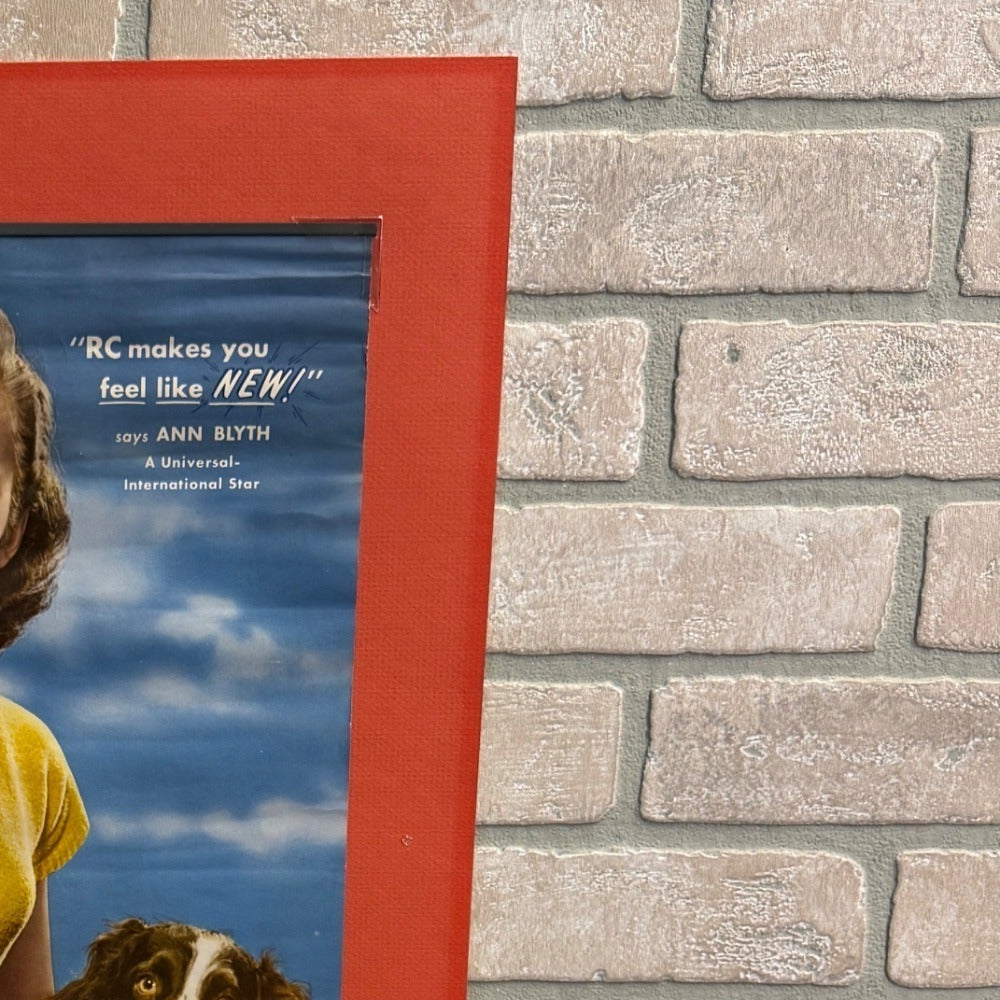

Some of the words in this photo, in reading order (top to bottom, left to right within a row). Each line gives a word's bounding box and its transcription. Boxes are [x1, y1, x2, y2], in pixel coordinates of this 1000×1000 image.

[128, 336, 212, 359] makes
[221, 342, 269, 363] you
[100, 376, 146, 399] feel
[156, 376, 203, 399] like
[115, 431, 149, 445] says
[156, 426, 203, 442] ANN
[214, 425, 270, 442] BLYTH
[145, 456, 155, 469] A
[161, 455, 241, 469] Universal-
[124, 478, 222, 491] International
[229, 477, 259, 490] Star
